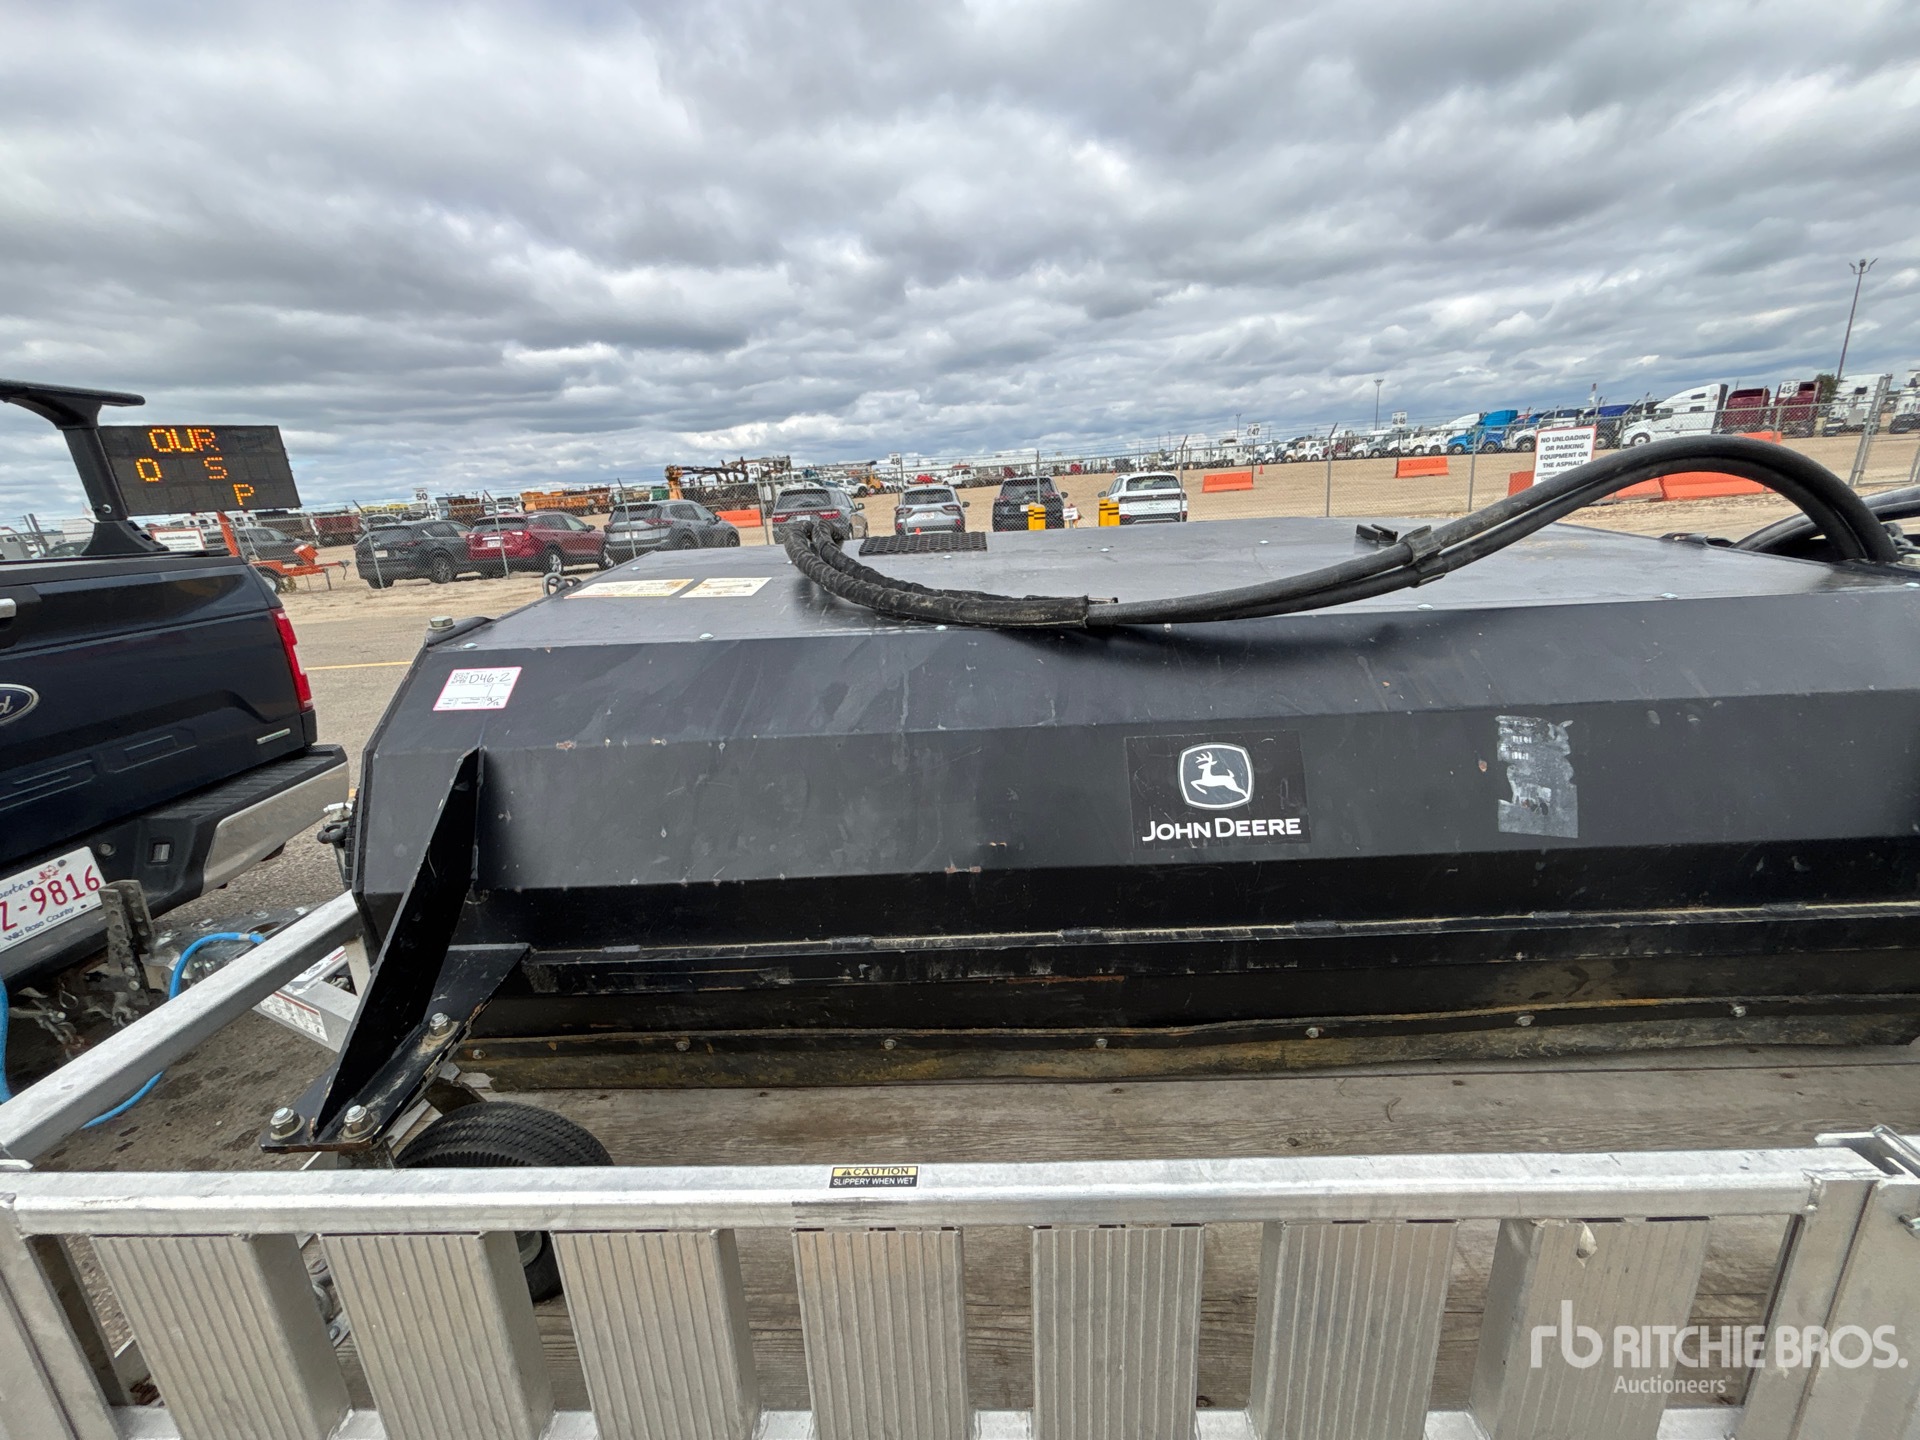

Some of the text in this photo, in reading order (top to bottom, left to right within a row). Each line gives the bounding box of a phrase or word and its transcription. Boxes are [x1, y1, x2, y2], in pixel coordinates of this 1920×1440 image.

[1781, 385, 1793, 394] 45
[148, 428, 220, 453] OUR
[1552, 434, 1590, 442] UNLOADING
[1540, 452, 1577, 460] EQUIPMENT
[890, 457, 900, 465] 48
[203, 456, 228, 480] S
[749, 466, 759, 474] 49
[232, 483, 255, 506] P
[416, 492, 427, 501] 50
[468, 672, 511, 684] D46-2
[1141, 818, 1302, 842] JOHN DEERE
[4, 907, 75, 941] Wild Rose County
[853, 1167, 909, 1176] CAUTION
[833, 1178, 871, 1186] SLIPPERY
[871, 1177, 895, 1185] WHEN
